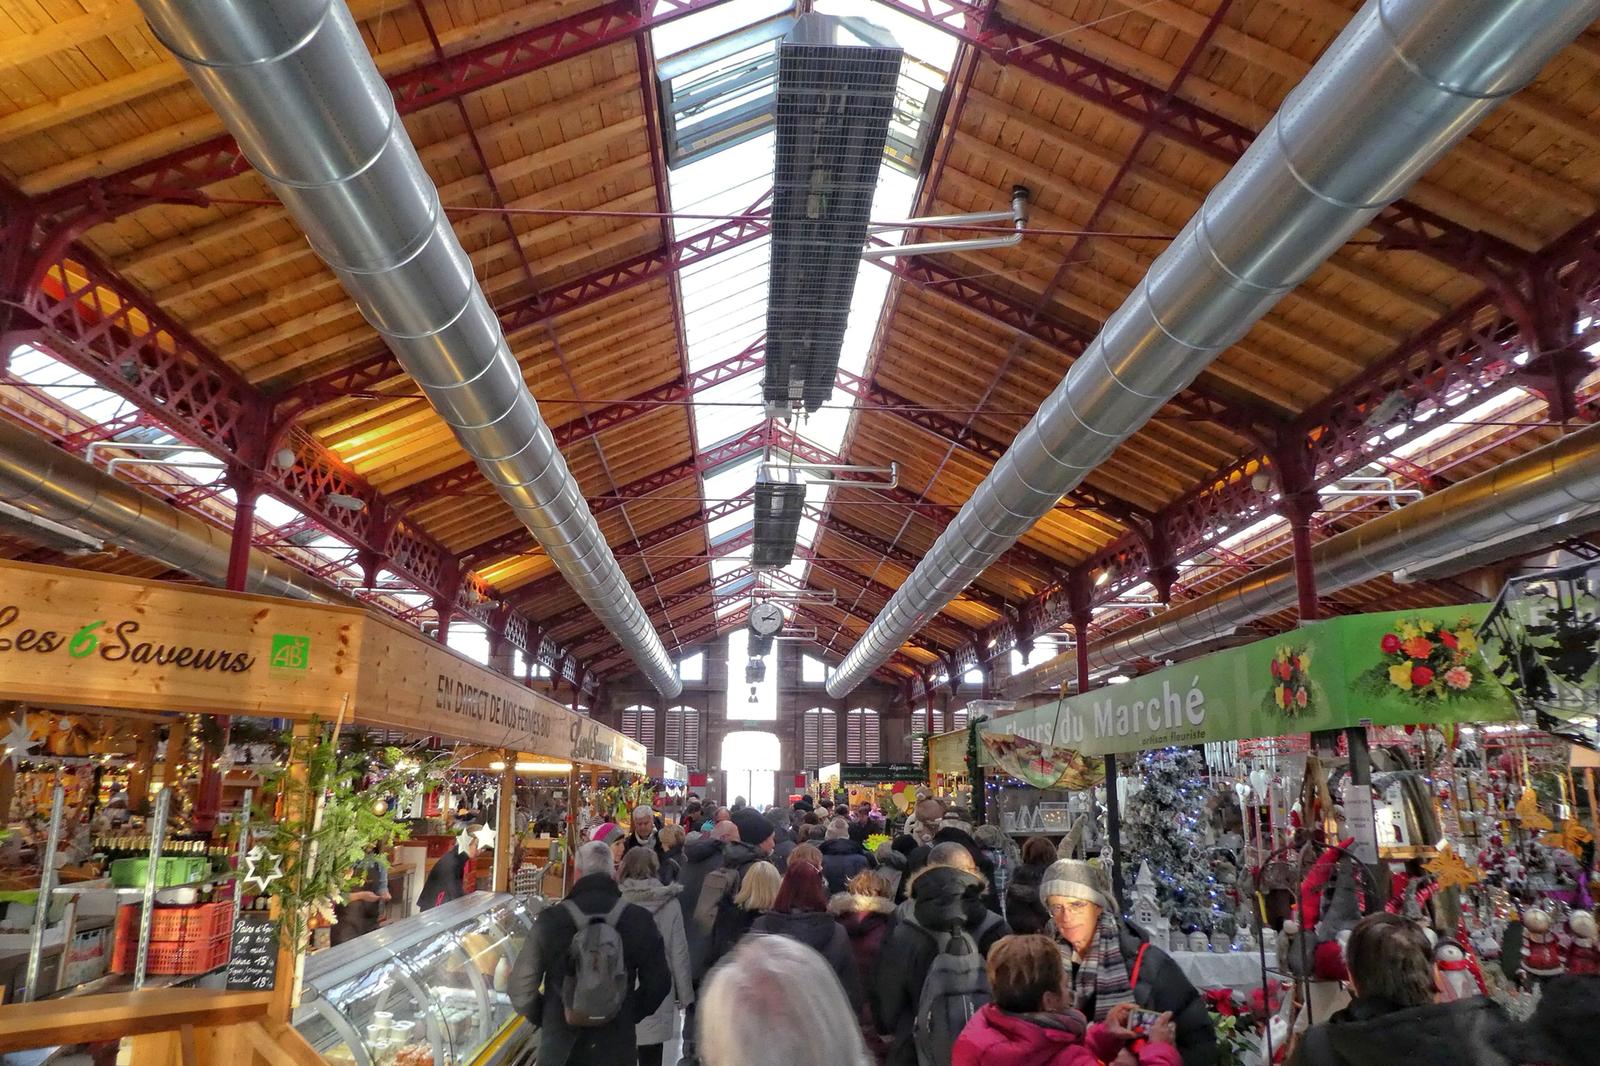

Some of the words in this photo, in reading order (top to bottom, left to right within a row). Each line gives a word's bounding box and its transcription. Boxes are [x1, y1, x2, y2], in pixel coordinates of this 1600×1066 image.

[0, 605, 66, 653] Les
[69, 620, 105, 658] 6
[101, 620, 256, 673] Saveurs
[272, 643, 302, 667] AB
[436, 674, 453, 711] EN
[455, 681, 489, 721] DIRECT
[490, 694, 501, 724] DE
[502, 698, 518, 729] NOS
[518, 705, 541, 735] FERMES
[1061, 705, 1084, 744] du
[1094, 675, 1206, 738] Marché
[1142, 735, 1168, 745] artisan
[1170, 729, 1206, 742] fleuriste
